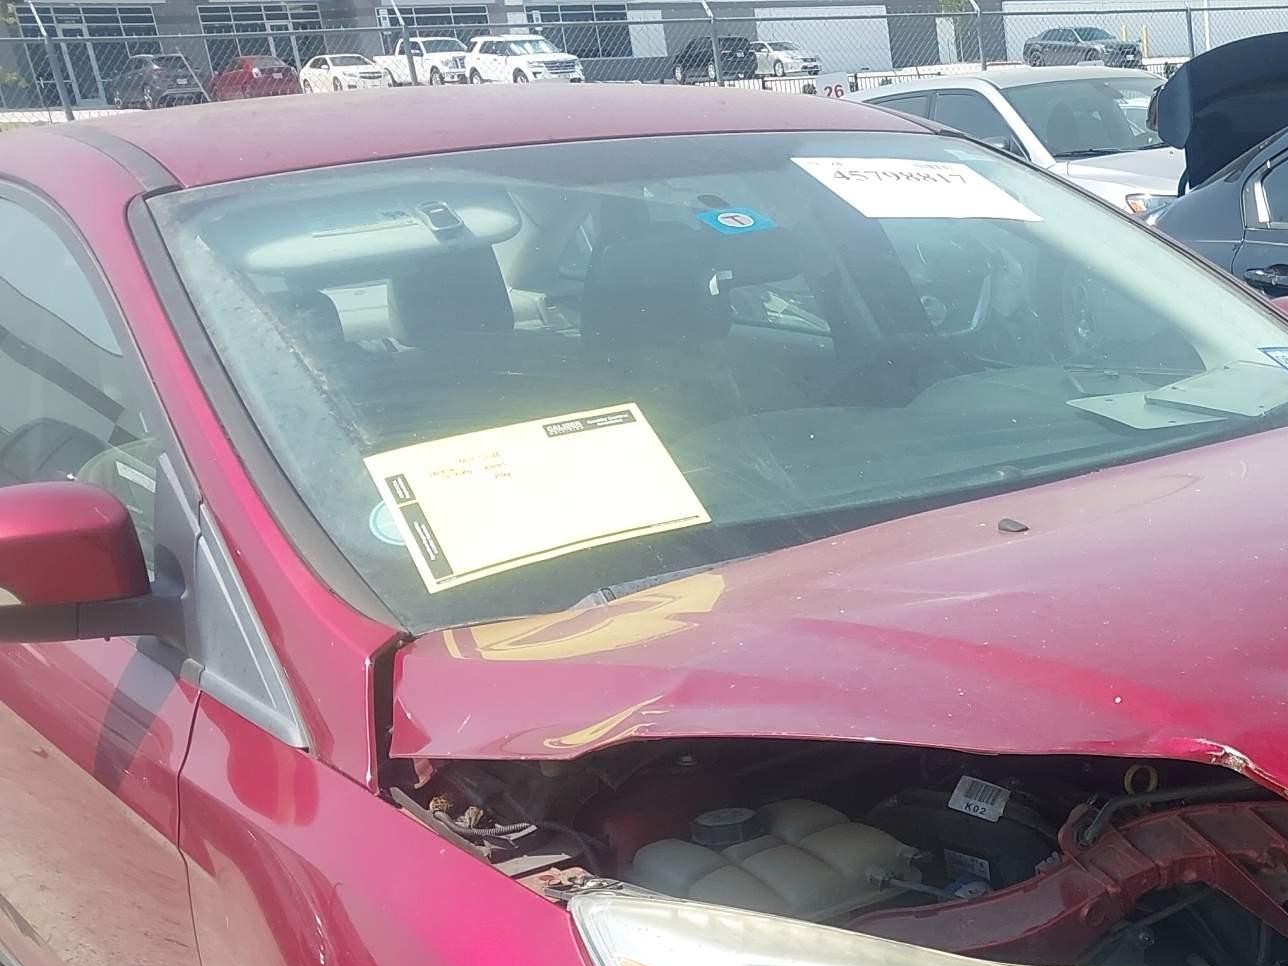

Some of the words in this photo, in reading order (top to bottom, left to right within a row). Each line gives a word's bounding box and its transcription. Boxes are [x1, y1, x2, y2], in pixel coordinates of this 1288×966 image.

[823, 84, 845, 99] 26
[832, 169, 968, 185] 45798817
[965, 803, 986, 815] K02
